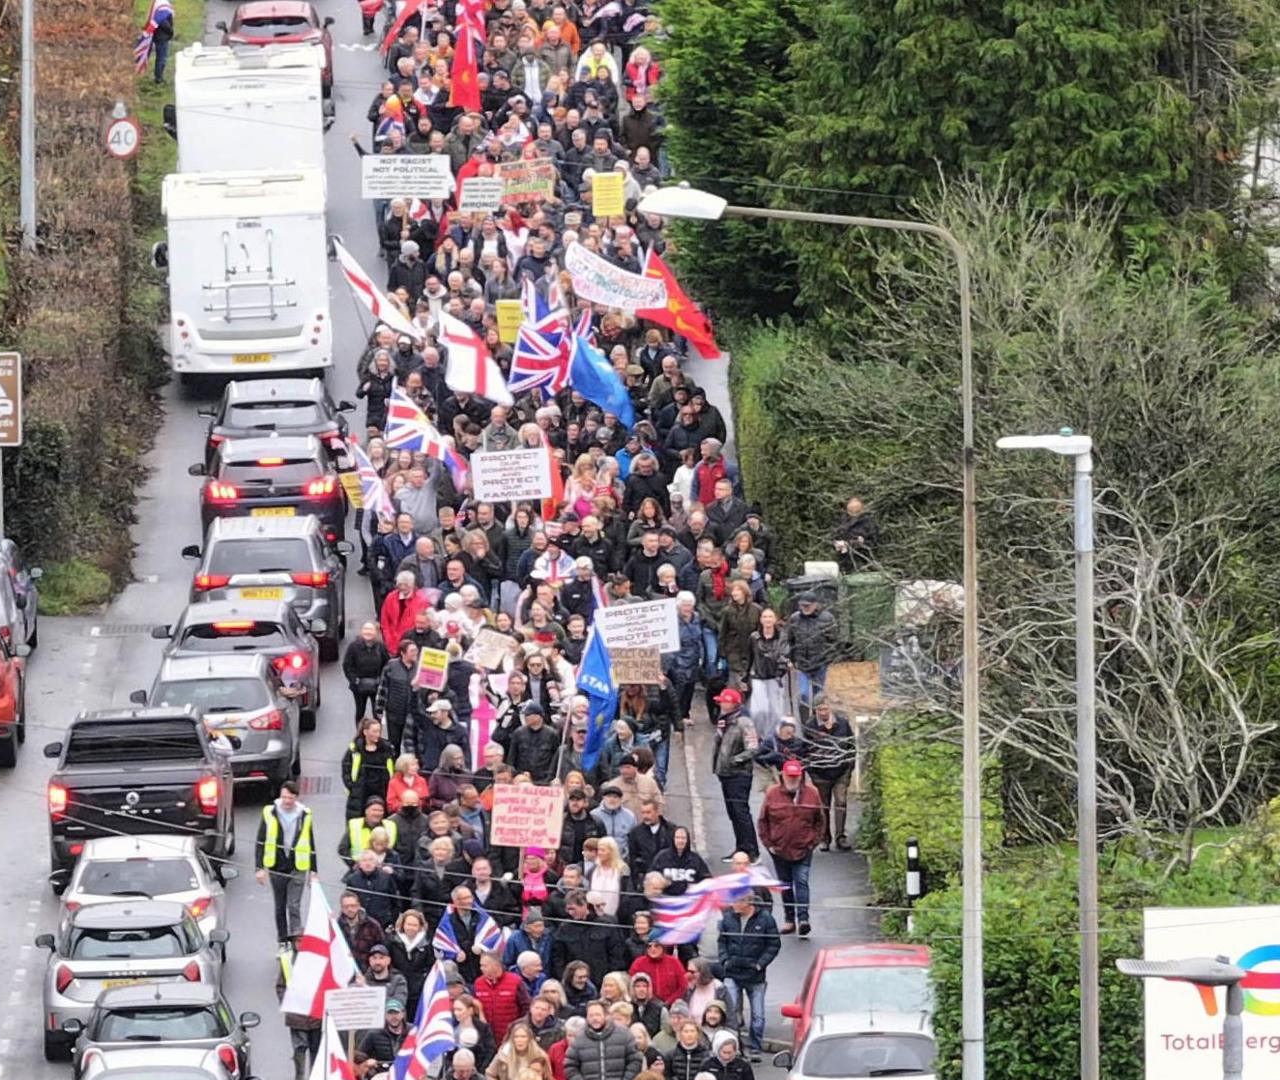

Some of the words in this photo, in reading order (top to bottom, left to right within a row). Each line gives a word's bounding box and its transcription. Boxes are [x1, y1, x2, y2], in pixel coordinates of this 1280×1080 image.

[111, 129, 134, 146] 40
[480, 453, 538, 461] PROTECT
[482, 476, 540, 485] PROTECT
[483, 489, 542, 498] FAMILIES
[605, 604, 665, 617] PROTECT
[607, 629, 668, 643] PROTECT
